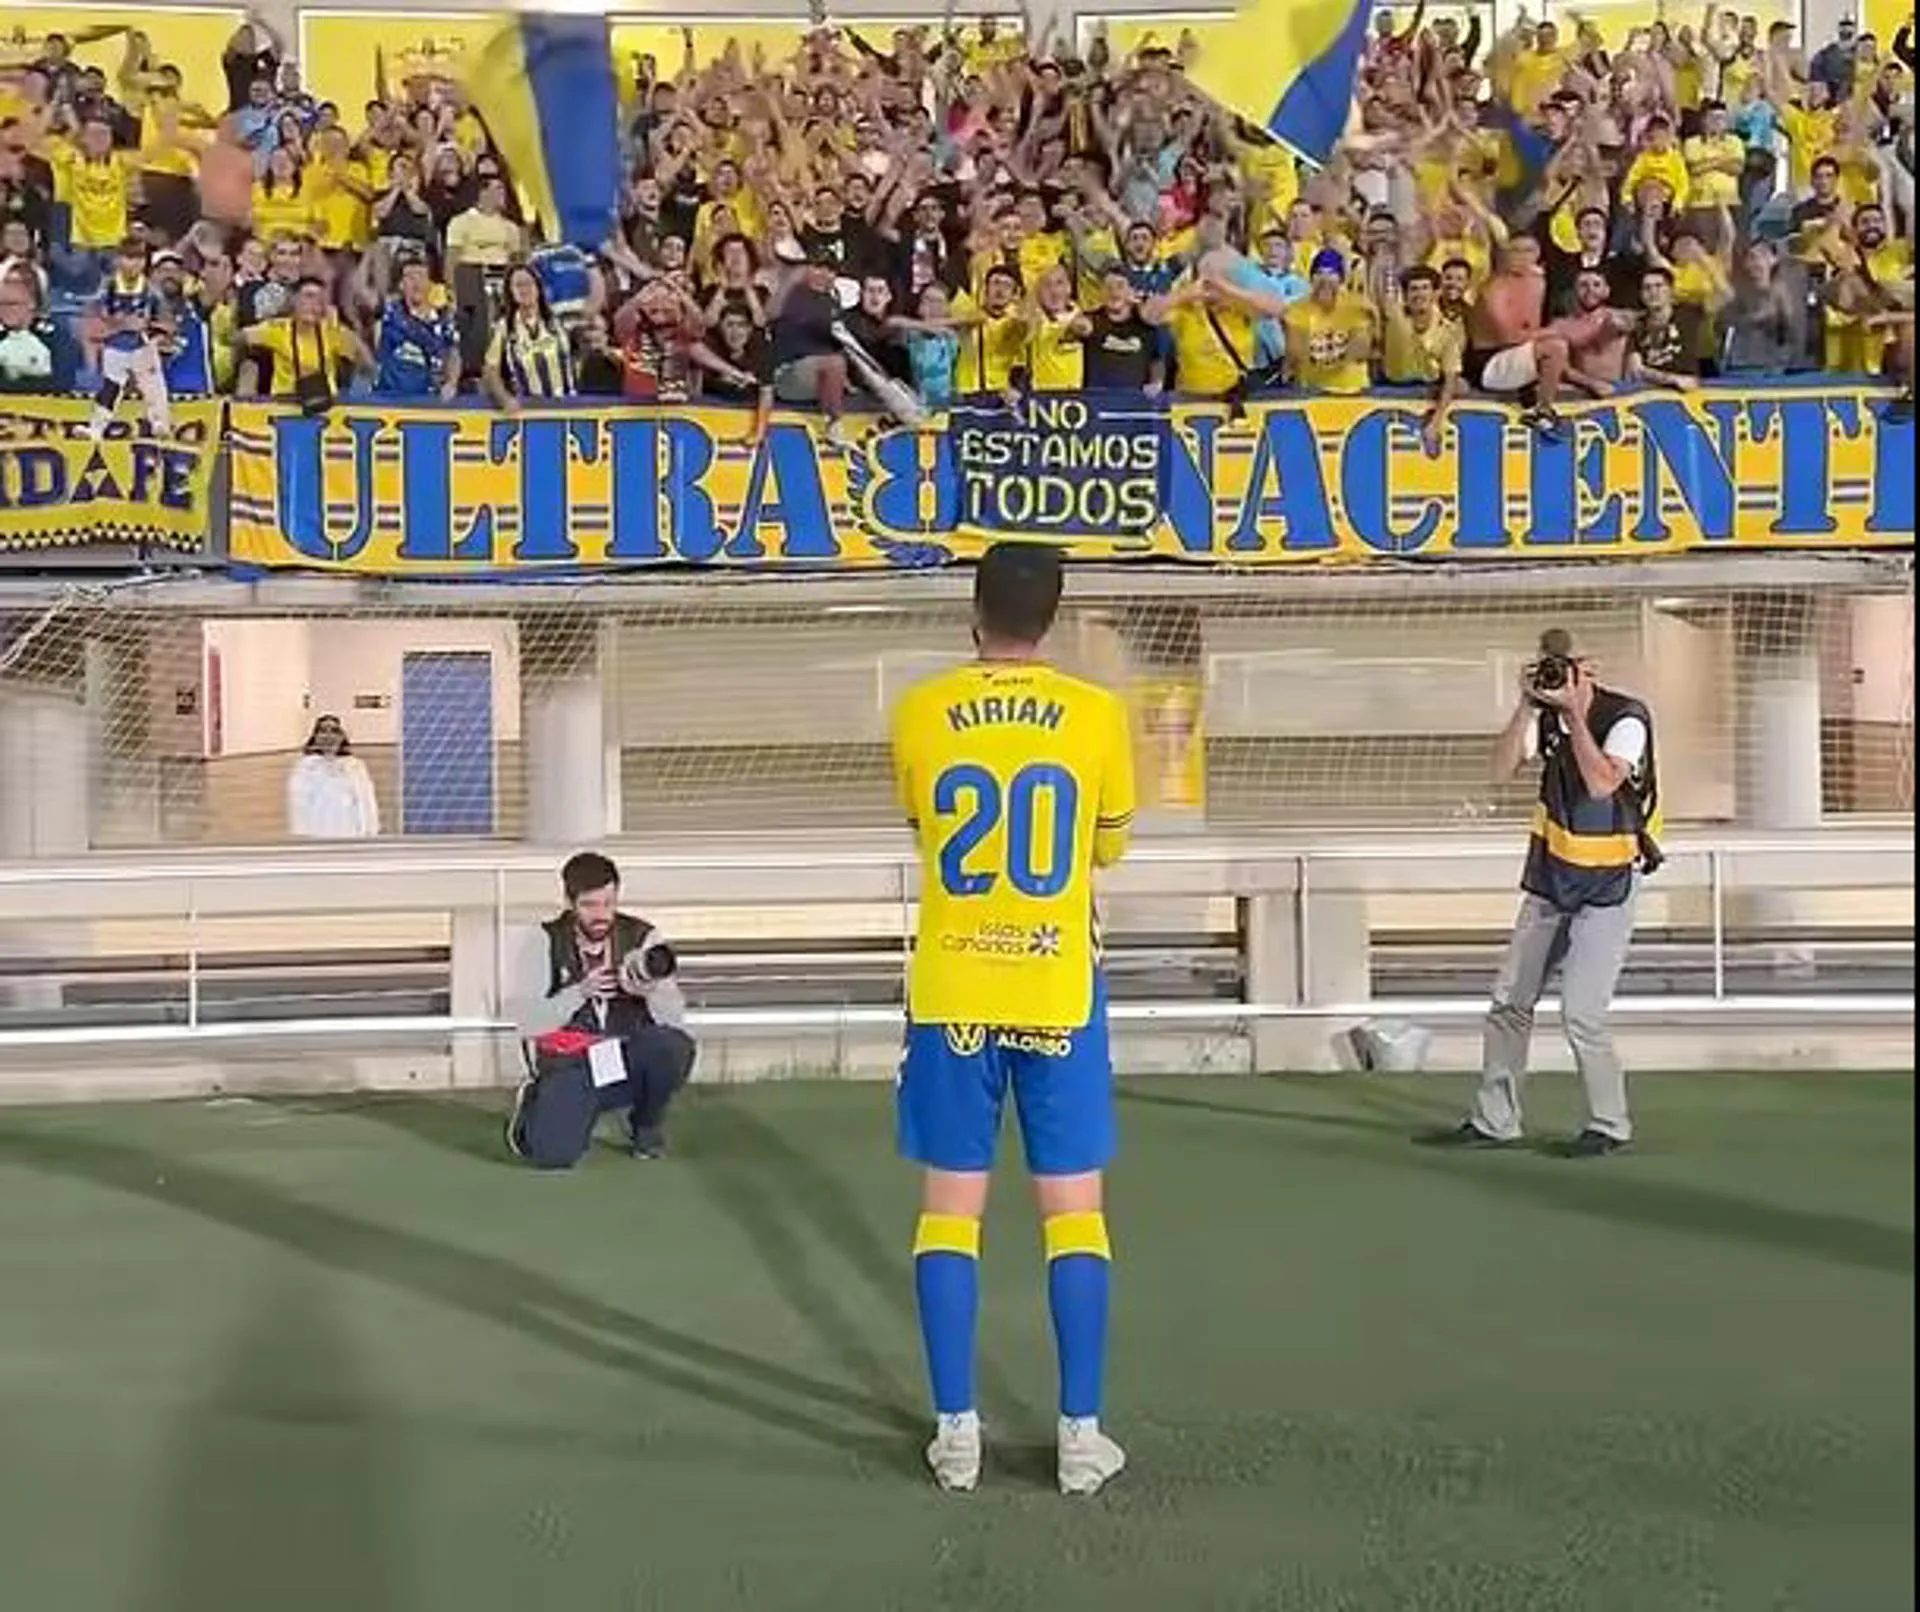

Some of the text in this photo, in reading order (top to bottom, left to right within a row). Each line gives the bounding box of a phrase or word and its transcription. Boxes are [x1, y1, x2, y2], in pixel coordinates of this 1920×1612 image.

[1028, 399, 1087, 430] NO
[960, 428, 1159, 471] ESTAMOS
[266, 415, 841, 561] ULTRA
[964, 470, 1158, 528] TODOS
[946, 694, 1066, 732] KIRIAN
[933, 761, 1079, 898] 20
[996, 1031, 1072, 1057] ALONSO
